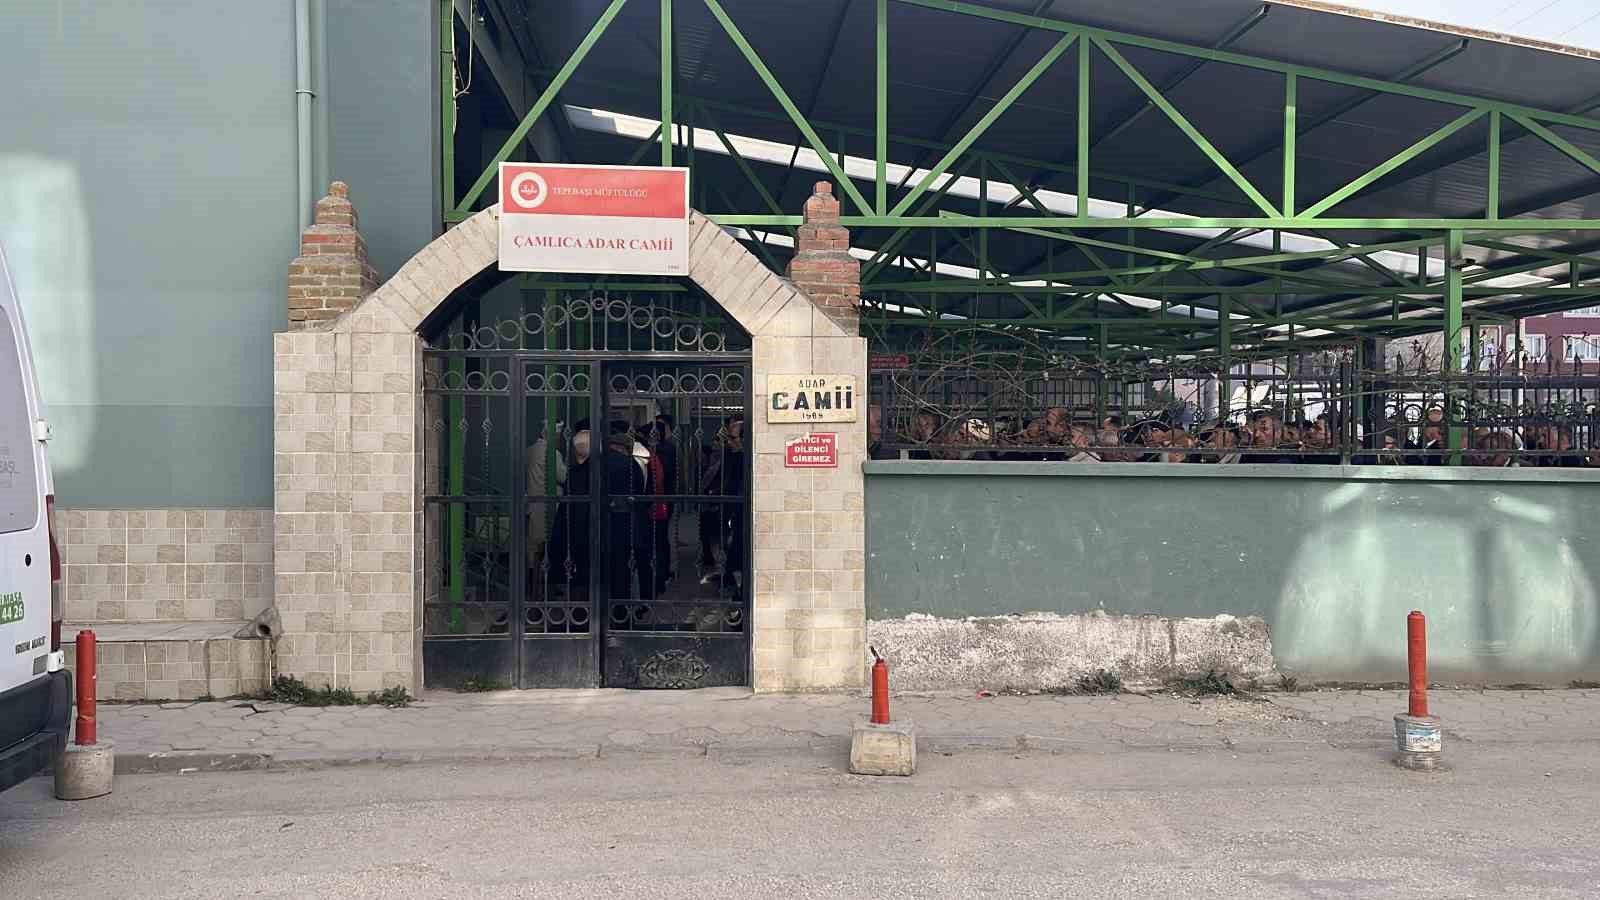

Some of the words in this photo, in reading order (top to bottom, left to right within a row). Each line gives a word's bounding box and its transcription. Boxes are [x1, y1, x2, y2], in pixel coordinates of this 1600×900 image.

[513, 235, 582, 248] ÇAMLICA
[586, 238, 625, 249] ADAR
[798, 379, 826, 388] ADAR
[794, 445, 829, 454] DİLENCİ
[792, 454, 832, 463] GİREMEZ
[13, 603, 24, 618] 26
